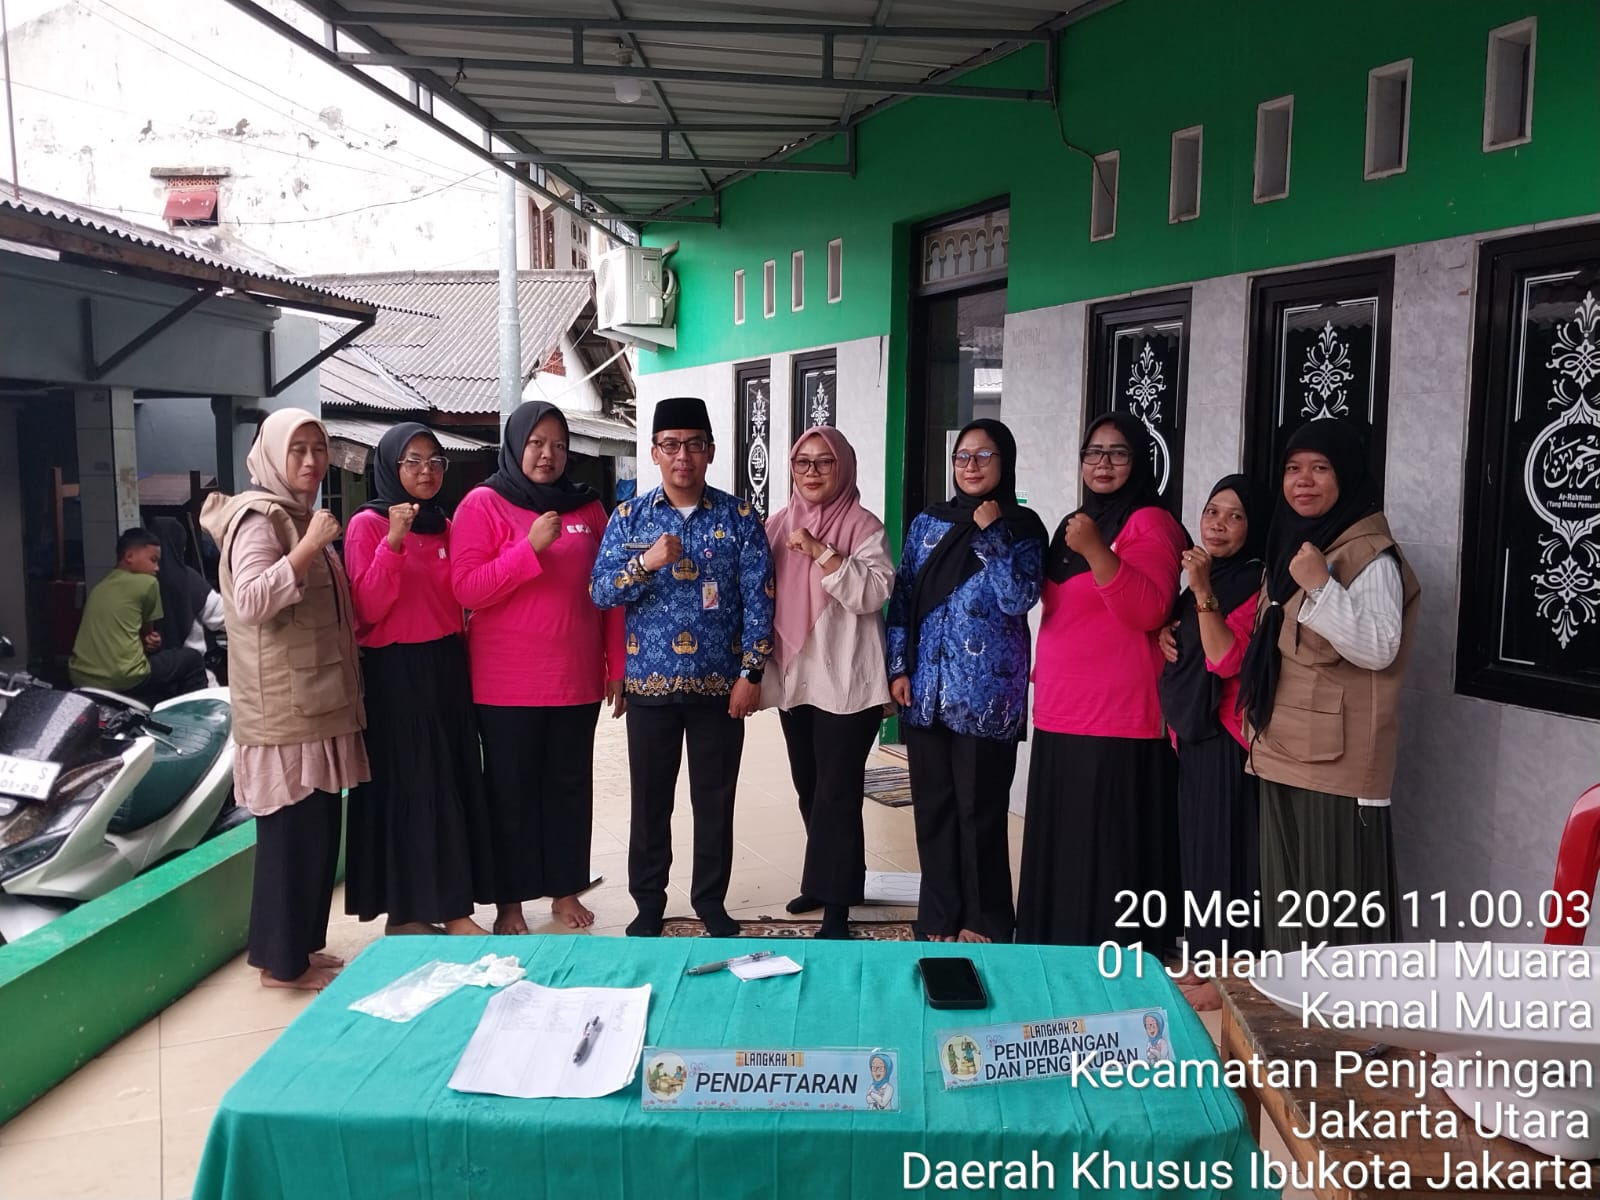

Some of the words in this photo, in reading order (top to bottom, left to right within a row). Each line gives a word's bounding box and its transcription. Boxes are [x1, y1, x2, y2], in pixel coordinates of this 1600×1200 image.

[1029, 1022, 1071, 1039] LANGKAH
[1071, 1021, 1079, 1034] 2
[994, 1032, 1120, 1061] PENIMBANGAN
[744, 1052, 788, 1067] LANGKAH
[790, 1053, 796, 1066] 1
[985, 1062, 1021, 1080] DAN
[695, 1072, 859, 1094] PENDAFTARAN
